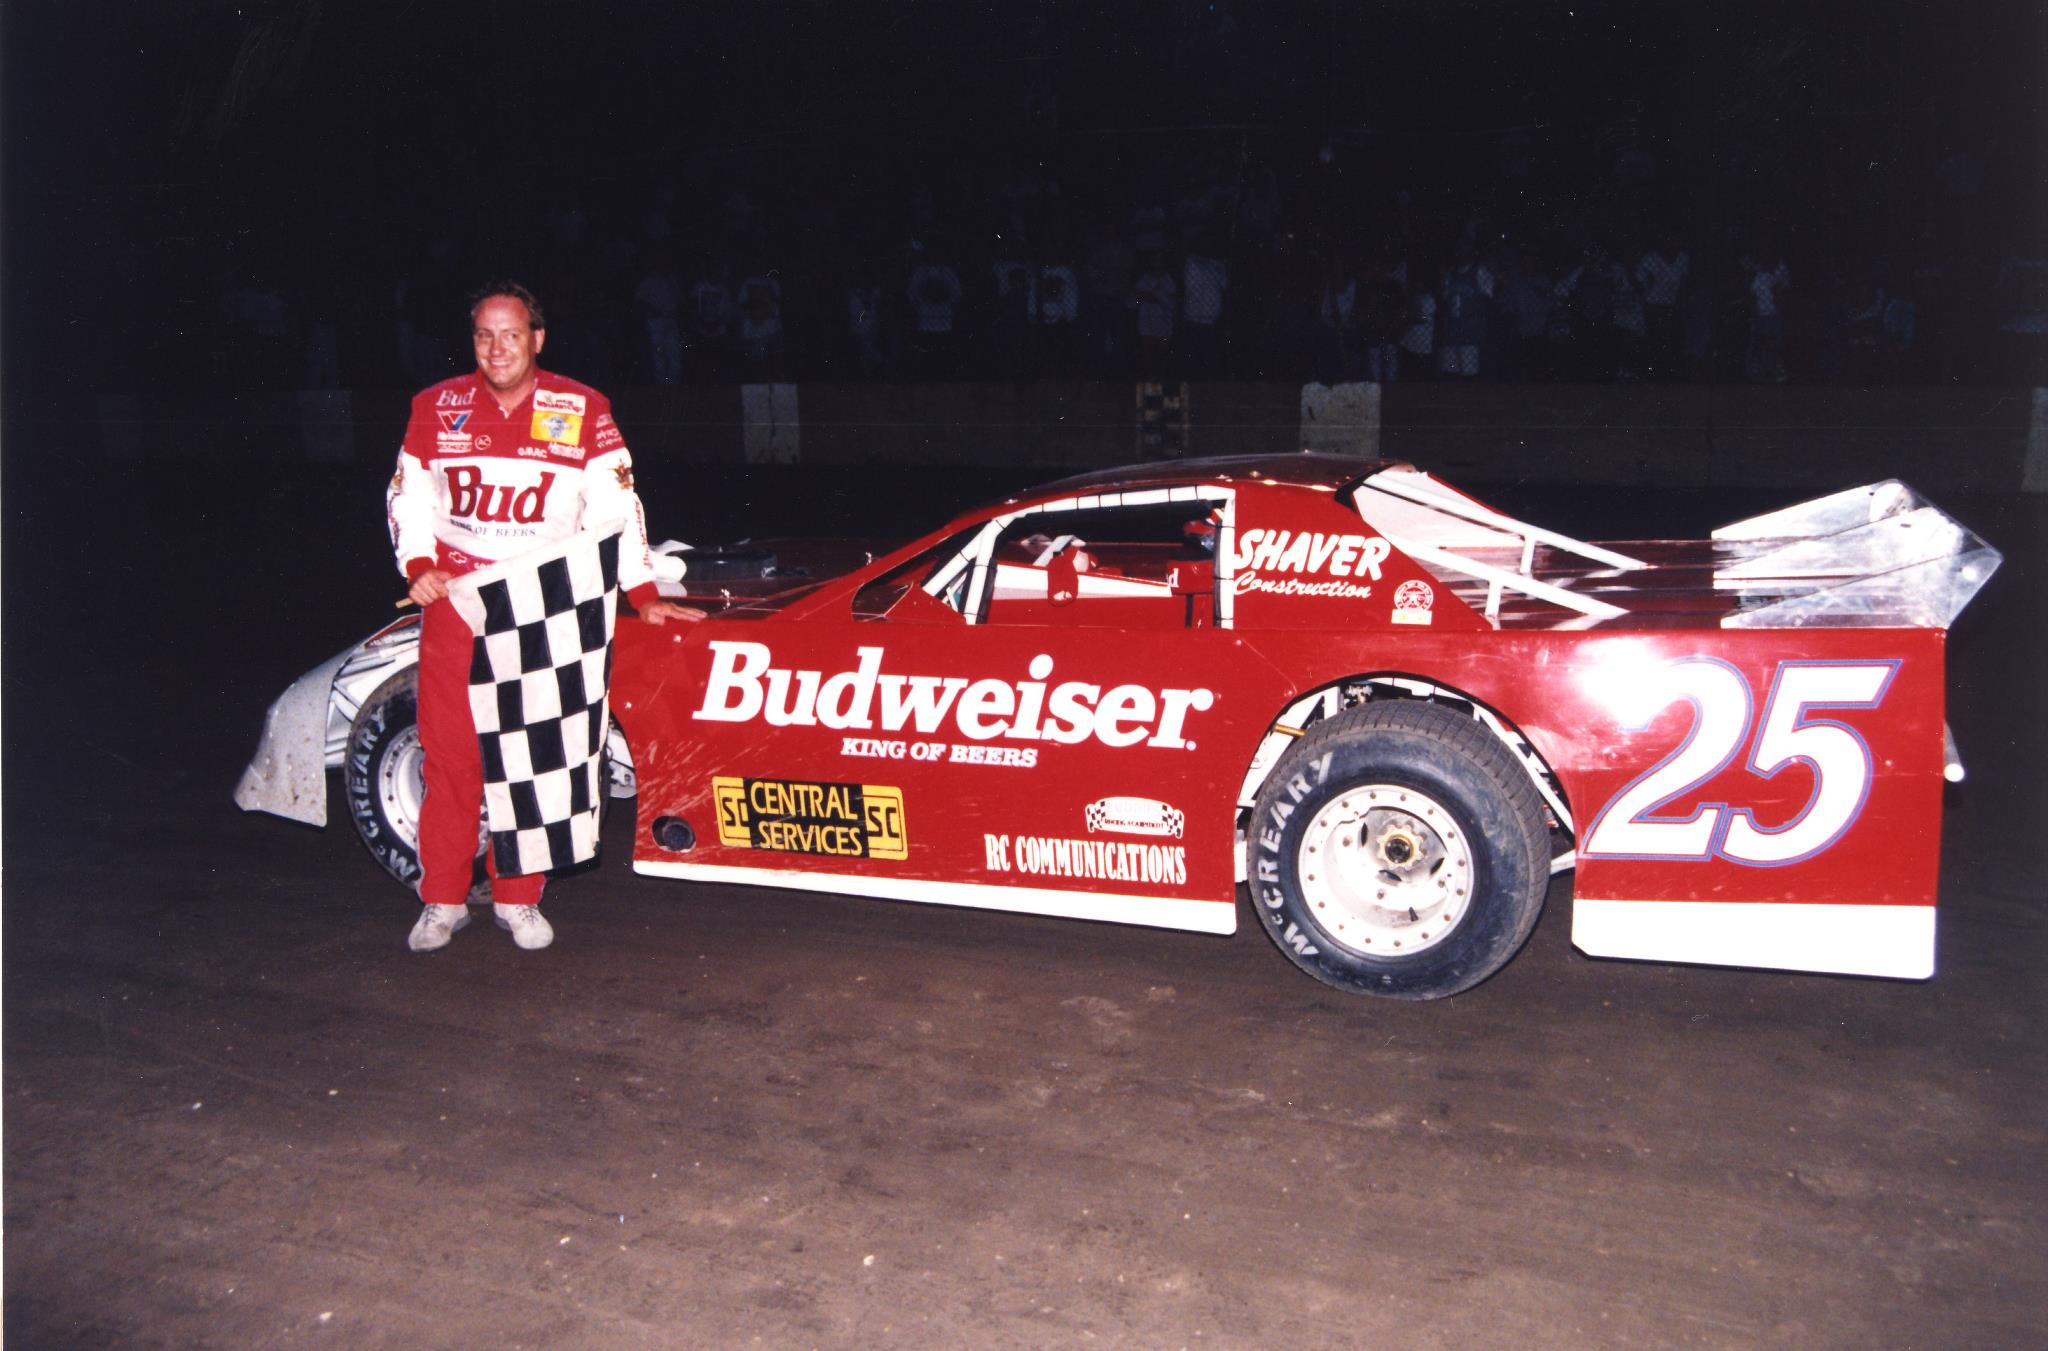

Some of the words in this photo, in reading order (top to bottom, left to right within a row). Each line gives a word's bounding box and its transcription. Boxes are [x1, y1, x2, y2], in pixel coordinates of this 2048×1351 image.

[436, 388, 477, 406] Bud
[444, 465, 556, 524] Bud
[1233, 529, 1391, 581] SHAVER
[1233, 571, 1372, 599] Construction
[840, 737, 907, 760] KING
[910, 742, 947, 762] OF
[949, 744, 1039, 768] BEERS
[1578, 655, 1903, 868] 25
[750, 781, 858, 821] CENTRAL
[758, 821, 863, 856] SERVICES
[984, 834, 1011, 872] RC
[1015, 836, 1187, 885] COMMUNICATIONS
